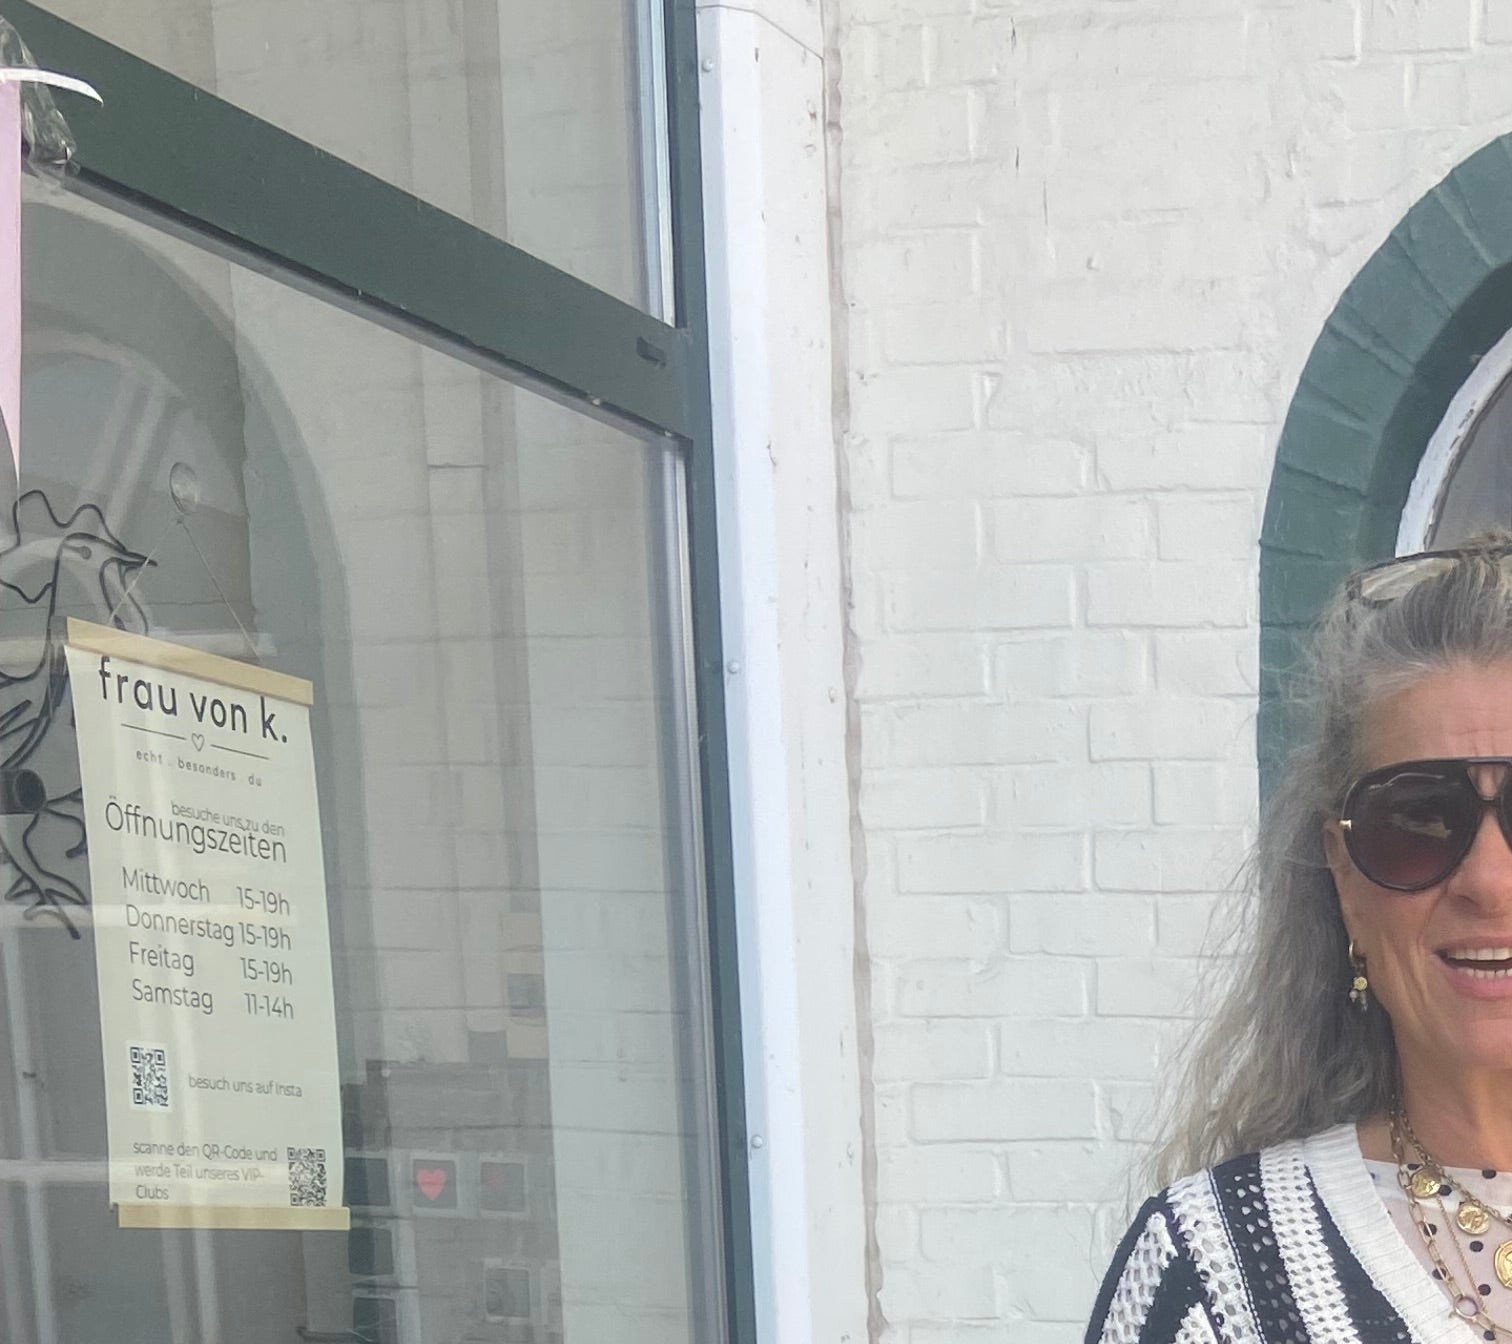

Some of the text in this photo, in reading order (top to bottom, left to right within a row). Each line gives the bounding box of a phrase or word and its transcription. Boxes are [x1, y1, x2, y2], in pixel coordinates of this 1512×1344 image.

[99, 656, 288, 743] frau von k.
[136, 749, 262, 787] echt besonders du
[105, 795, 287, 863] Öffnungszeiten
[171, 800, 220, 824] besuche
[244, 820, 259, 832] zu
[262, 820, 285, 837] den
[122, 866, 290, 916] Mittwoch 15-19h
[126, 904, 292, 950] Donnerstag 15-19h
[129, 941, 293, 985] Freitag 15-19h
[132, 978, 294, 1020] Samstag 11-14h
[188, 1073, 303, 1097] besuch uns auf Insta
[133, 1142, 278, 1161] scanne den QR-Code und
[134, 1164, 171, 1177] werde
[173, 1163, 193, 1179] Teil
[195, 1168, 240, 1181] unseres
[135, 1184, 170, 1200] Clubs
